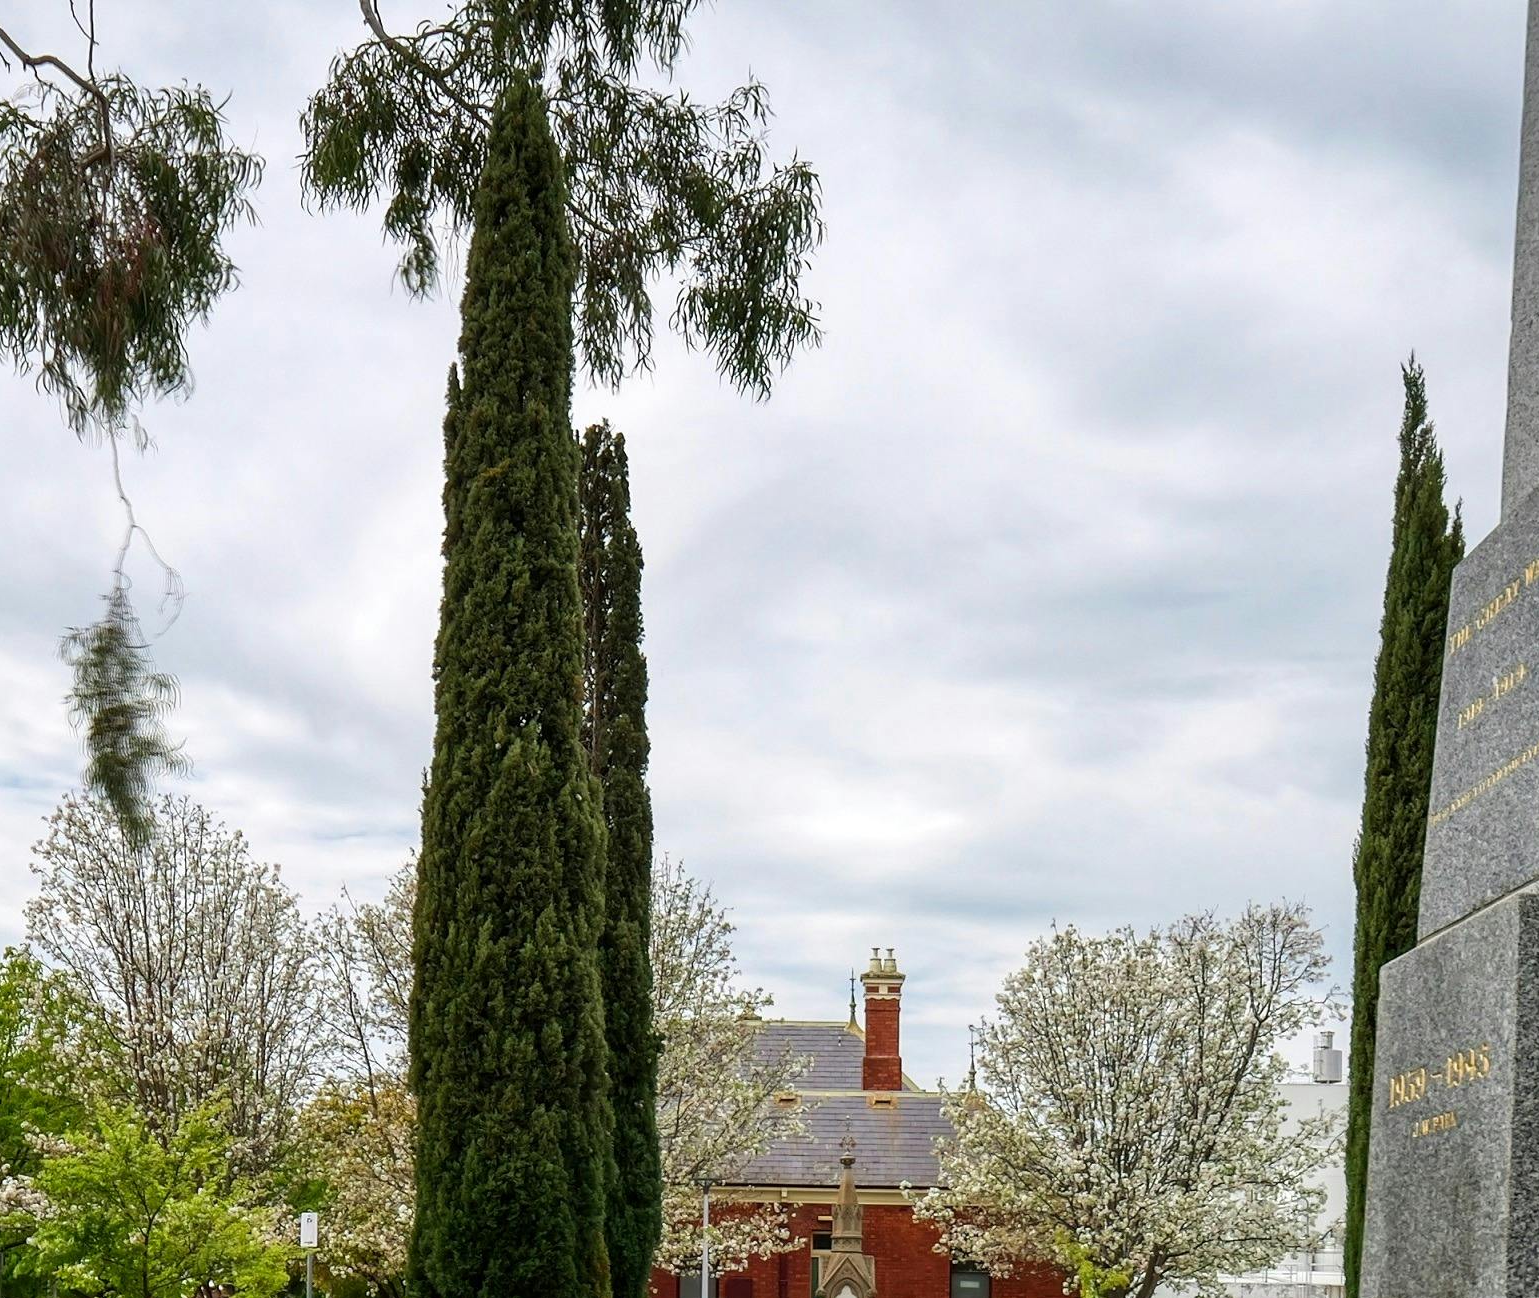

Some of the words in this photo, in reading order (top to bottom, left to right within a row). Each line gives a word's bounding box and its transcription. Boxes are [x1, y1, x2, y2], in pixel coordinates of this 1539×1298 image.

[1449, 624, 1473, 654] THE
[1476, 579, 1521, 629] GREAT
[1389, 1067, 1426, 1109] 1939
[1445, 1044, 1490, 1089] 1945
